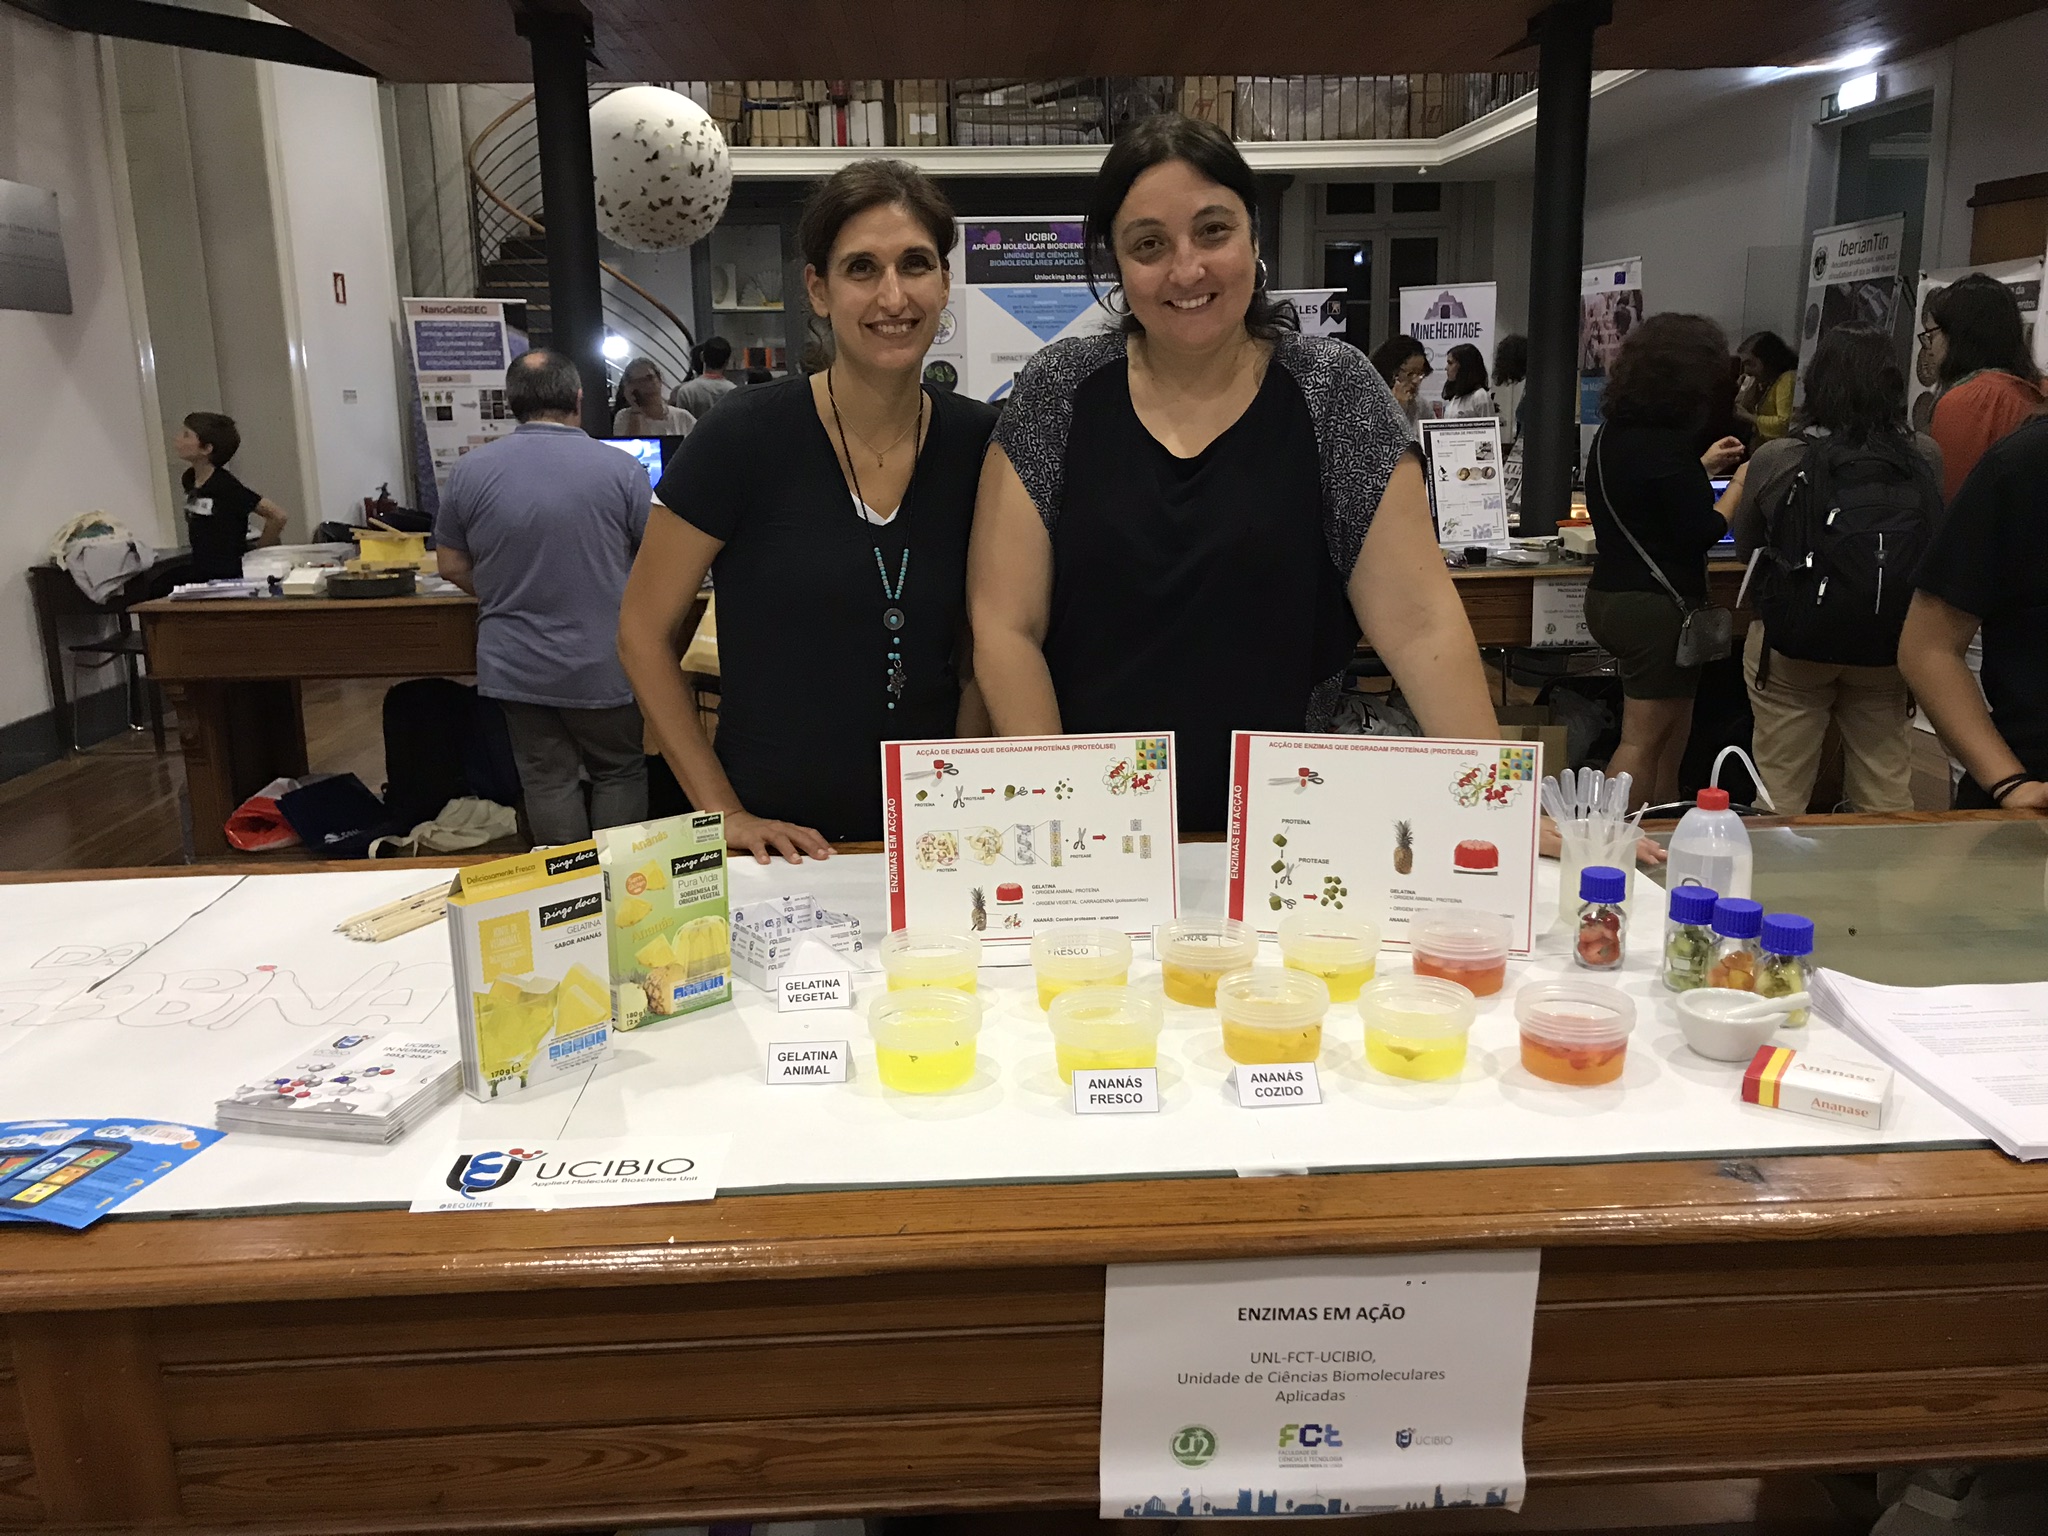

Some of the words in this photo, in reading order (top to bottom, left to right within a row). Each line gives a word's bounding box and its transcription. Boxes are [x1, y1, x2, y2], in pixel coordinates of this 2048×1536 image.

[1025, 232, 1058, 242] UCIBIO
[1838, 232, 1889, 257] IberianTin
[972, 243, 1001, 251] APPLIED
[1047, 242, 1084, 250] BIOSCIENC
[1047, 251, 1079, 259] CIÊNCIAS
[421, 305, 488, 315] NanoCell2SEC
[916, 749, 940, 757] ACÇÃO
[1034, 744, 1071, 752] PROTEÍNAS
[1071, 743, 1117, 751] (PROTEÓLISE)
[1269, 741, 1292, 749] ACÇÃO
[1350, 744, 1389, 752] DEGRADAM
[1390, 746, 1429, 754] PROTEÍNAS
[1430, 747, 1479, 757] (PROTEÓLISE)
[1232, 785, 1243, 819] ACÇÃO
[887, 797, 898, 833] ACÇÃO
[1232, 819, 1241, 836] EM
[631, 831, 669, 853] Ananás
[888, 834, 898, 850] EM
[549, 858, 574, 875] pingo
[575, 850, 596, 862] doce
[674, 859, 698, 875] pingo
[700, 851, 720, 862] doce
[1230, 838, 1241, 880] ENZIMAS
[1298, 857, 1330, 865] PROTEASE
[466, 868, 515, 885] Deliciosamente
[889, 850, 899, 893] ENZIMAS
[678, 878, 698, 889] Pura
[700, 872, 719, 884] Vida
[678, 896, 699, 906] ORIGEM
[700, 890, 721, 901] VEGETAL
[680, 886, 711, 899] SOBREMESA
[543, 907, 573, 926] pingo
[575, 895, 600, 910] doce
[566, 919, 601, 935] GELATINA
[554, 938, 575, 950] SABOR
[576, 930, 602, 944] ANANÁS
[785, 978, 841, 991] GELATINA
[787, 991, 839, 1003] VEGETAL
[395, 1046, 449, 1055] NUMBERS
[777, 1050, 838, 1062] GELATINA
[490, 1070, 505, 1079] 170
[783, 1065, 831, 1076] ANIMAL
[1250, 1070, 1304, 1084] ANANÁS
[1793, 1062, 1876, 1084] Ananase
[1088, 1075, 1143, 1090] ANANÁS
[1089, 1093, 1143, 1105] FRESCO
[1254, 1086, 1304, 1098] COZIDO
[1811, 1097, 1869, 1118] Ananase
[536, 1157, 695, 1180] UCIBIO
[531, 1180, 570, 1188] Applied
[621, 1176, 677, 1184] Biosciences
[1237, 1307, 1318, 1321] ENZIMAS
[1323, 1307, 1351, 1321] EM
[1355, 1303, 1406, 1324] AÇÃO
[1250, 1350, 1377, 1365] UNL-FCT-UCIBIO,
[1177, 1371, 1240, 1385] Unidade
[1244, 1371, 1264, 1384] de
[1267, 1370, 1328, 1384] Ciências
[1332, 1368, 1446, 1383] Biomoleculares
[1275, 1390, 1346, 1405] Aplicadas
[1415, 1435, 1454, 1446] UCIBIO
